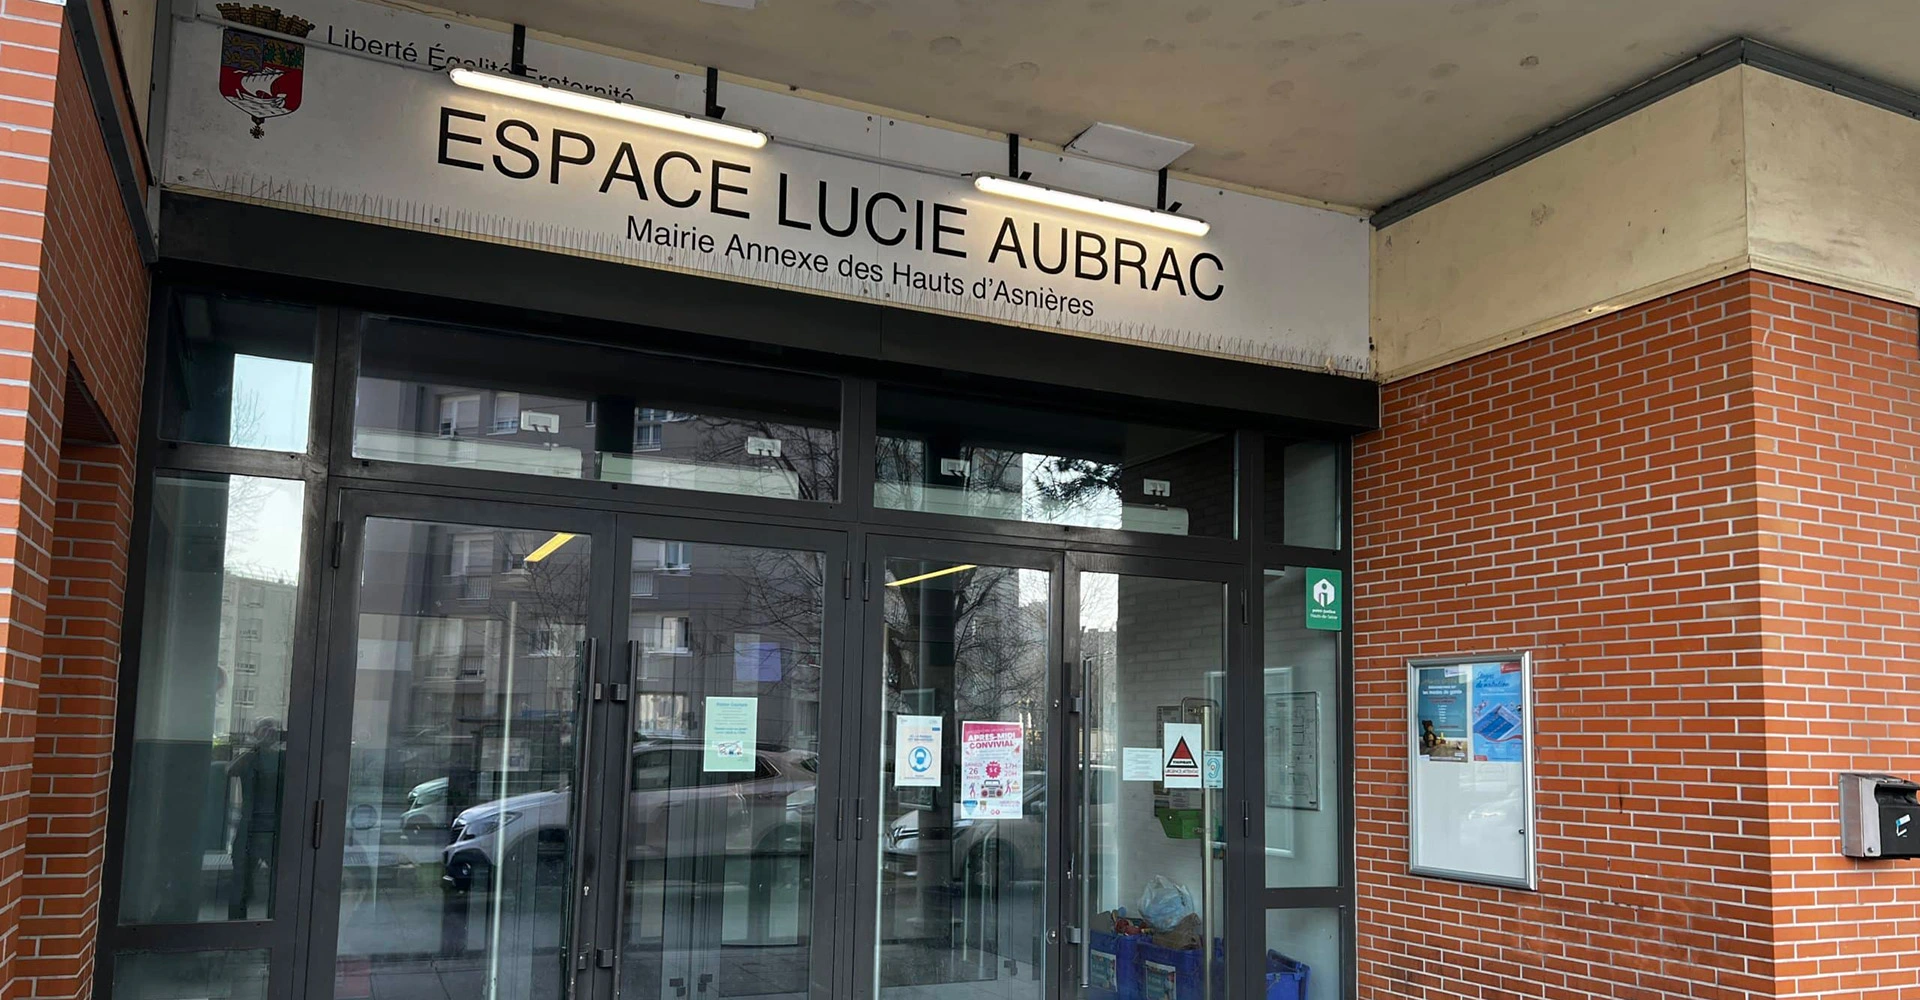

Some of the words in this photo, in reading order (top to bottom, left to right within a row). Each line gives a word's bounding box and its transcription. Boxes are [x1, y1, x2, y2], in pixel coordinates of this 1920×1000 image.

[327, 25, 419, 63] Liberté
[437, 106, 751, 220] ESPACE
[778, 172, 967, 259] LUCIE
[988, 217, 1224, 302] AUBRAC
[627, 215, 715, 255] Mairie
[724, 233, 829, 273] Annexe
[837, 254, 883, 284] des
[893, 261, 964, 296] Hauts
[970, 740, 1015, 749] CONVIVIAL
[968, 767, 979, 775] 26
